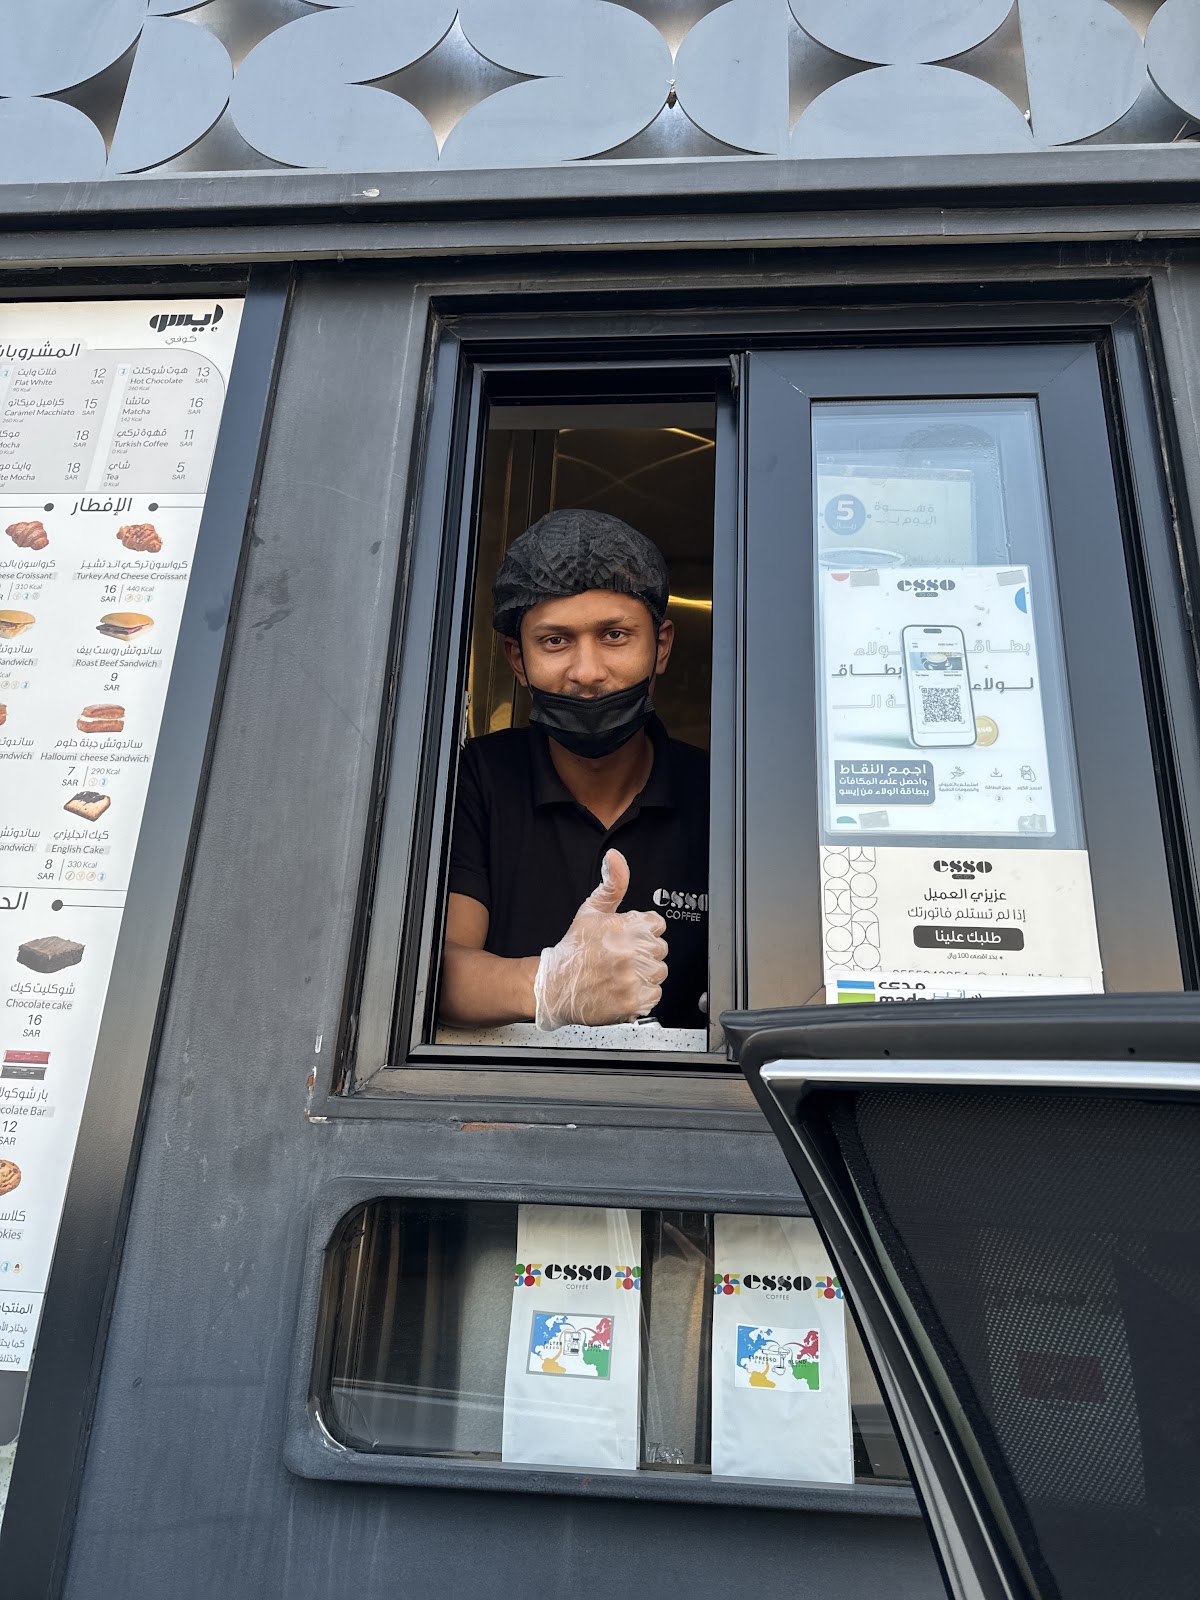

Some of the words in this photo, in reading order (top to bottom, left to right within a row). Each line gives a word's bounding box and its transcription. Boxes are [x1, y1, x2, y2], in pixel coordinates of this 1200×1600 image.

[165, 336, 197, 346] كوفي
[18, 368, 37, 378] وايت
[38, 368, 57, 377] فلات
[94, 368, 107, 378] 12
[166, 367, 188, 376] هوت
[197, 366, 210, 378] 13
[36, 398, 65, 408] كراميل
[84, 398, 98, 409] 15
[125, 396, 150, 406] ماتشا
[190, 397, 204, 408] 16
[76, 430, 90, 441] 18
[116, 429, 140, 438] تركي
[141, 428, 167, 438] قهوة
[184, 429, 194, 440] 11
[12, 462, 31, 471] وايت
[67, 462, 81, 474] 18
[108, 460, 130, 471] شاي
[176, 462, 186, 473] 5
[70, 497, 132, 516] الإفطار
[836, 500, 854, 521] 5
[18, 560, 56, 569] كرواسون
[149, 560, 188, 570] كرواسون
[104, 585, 117, 594] 16
[896, 579, 956, 592] esso
[93, 646, 120, 656] روست
[120, 644, 162, 657] ساندوتش
[110, 672, 118, 682] 9
[54, 739, 78, 749] حلوم
[79, 740, 98, 749] جبنة
[100, 738, 143, 750] ساندوتش
[40, 752, 78, 761] Halloumi
[80, 753, 109, 761] cheese
[110, 754, 149, 763] Sandwich
[68, 766, 76, 776] 7
[840, 763, 884, 774] النقاط
[888, 764, 926, 776] اجمع
[839, 777, 878, 786] المكافآت
[899, 777, 928, 786] واحصل
[839, 787, 859, 796] إيسو
[860, 788, 873, 796] من
[875, 788, 898, 796] الولاء
[900, 787, 930, 796] ببطاقة
[53, 829, 87, 841] انجليزي
[88, 830, 109, 841] كيك
[51, 844, 81, 855] English
[83, 845, 104, 854] Cake
[44, 858, 53, 870] 8
[933, 860, 992, 873] esso
[37, 872, 54, 881] SAR
[923, 888, 967, 902] العميل
[970, 888, 1007, 903] عزيزي
[666, 909, 702, 922] COFFEE
[907, 906, 952, 920] فاتورتك
[954, 908, 993, 921] تستلم
[996, 908, 1010, 922] لم
[1013, 909, 1027, 923] إذا
[935, 930, 965, 945] علينا
[966, 931, 1002, 946] طلبك
[10, 982, 32, 994] كيك
[34, 982, 76, 997] شوكليت
[6, 999, 51, 1010] Chocolate
[52, 1001, 73, 1010] cake
[28, 1014, 43, 1026] 16
[22, 1029, 41, 1037] SAR
[36, 1089, 48, 1102] بار
[30, 1106, 47, 1116] Bar
[3, 1120, 18, 1133] 12
[544, 1264, 612, 1281] esso
[743, 1274, 812, 1292] esso
